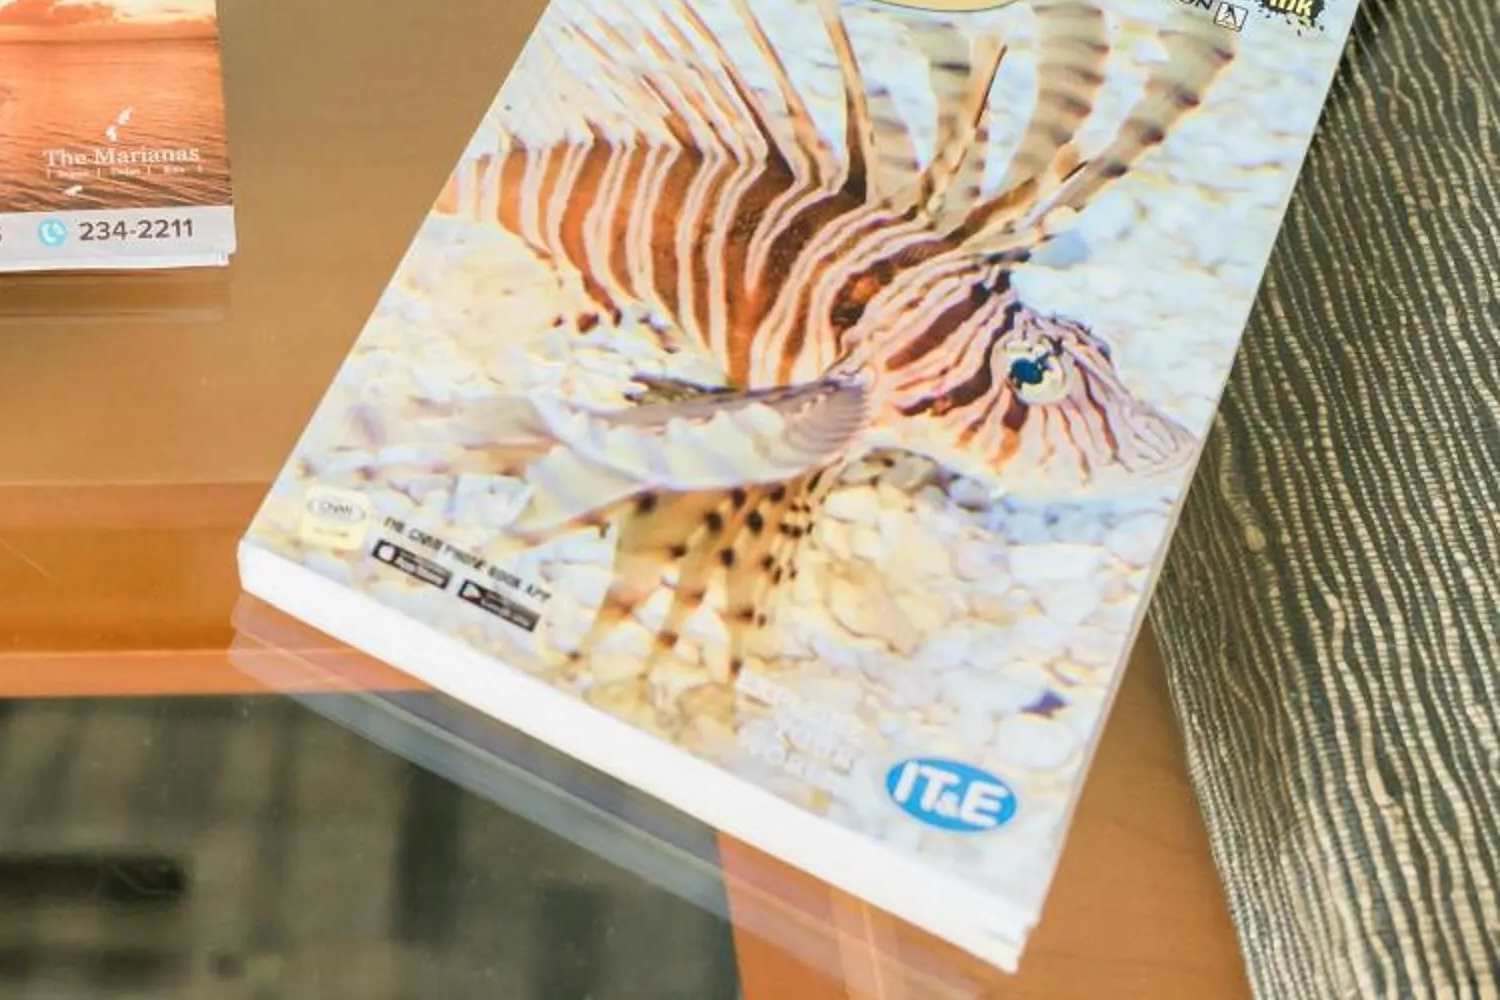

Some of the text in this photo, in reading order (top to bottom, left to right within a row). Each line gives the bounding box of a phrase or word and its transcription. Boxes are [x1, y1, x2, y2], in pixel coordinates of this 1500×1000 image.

[43, 146, 200, 167] The Marianas
[78, 217, 194, 243] 234-2211
